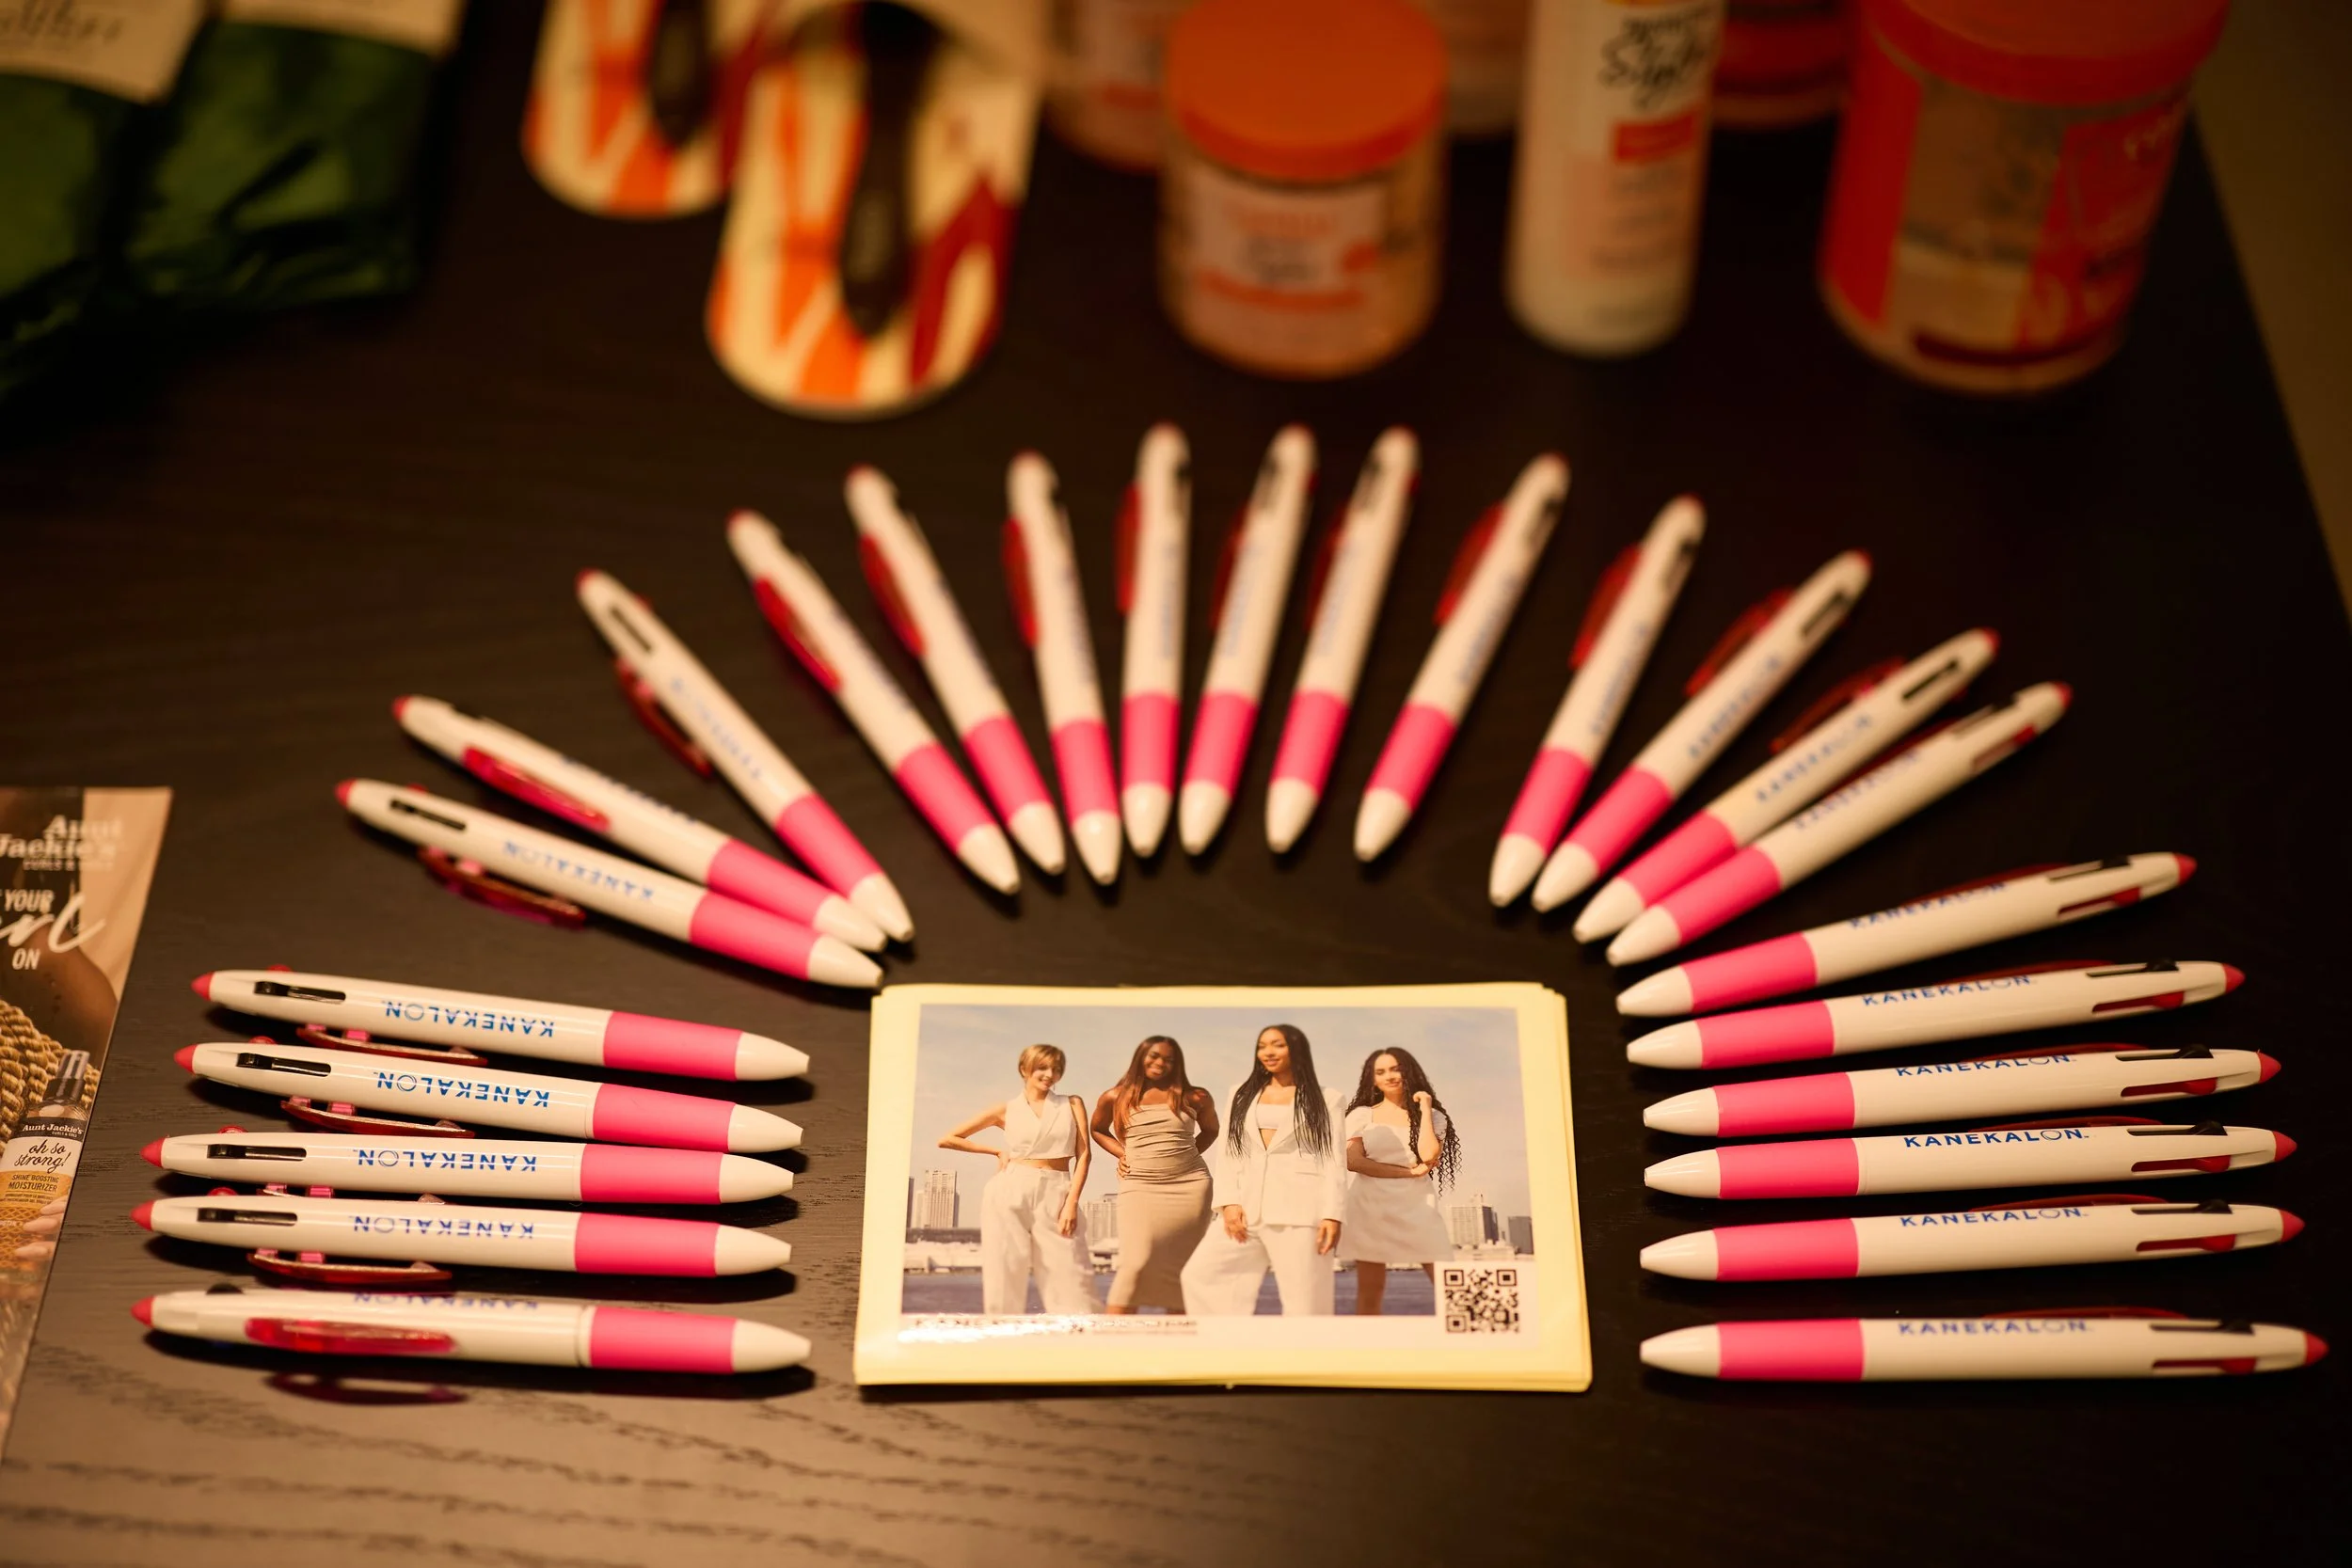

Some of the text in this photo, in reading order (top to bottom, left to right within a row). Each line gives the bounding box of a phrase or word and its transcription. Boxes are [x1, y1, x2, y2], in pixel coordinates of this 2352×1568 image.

[5, 889, 55, 912] YOUR
[12, 947, 40, 970] ON
[47, 1123, 83, 1135] Jackie's
[29, 1139, 66, 1154] oh so
[14, 1152, 72, 1174] strong!
[31, 1174, 60, 1183] BOOSTING
[8, 1181, 58, 1194] MOISTURIZER
